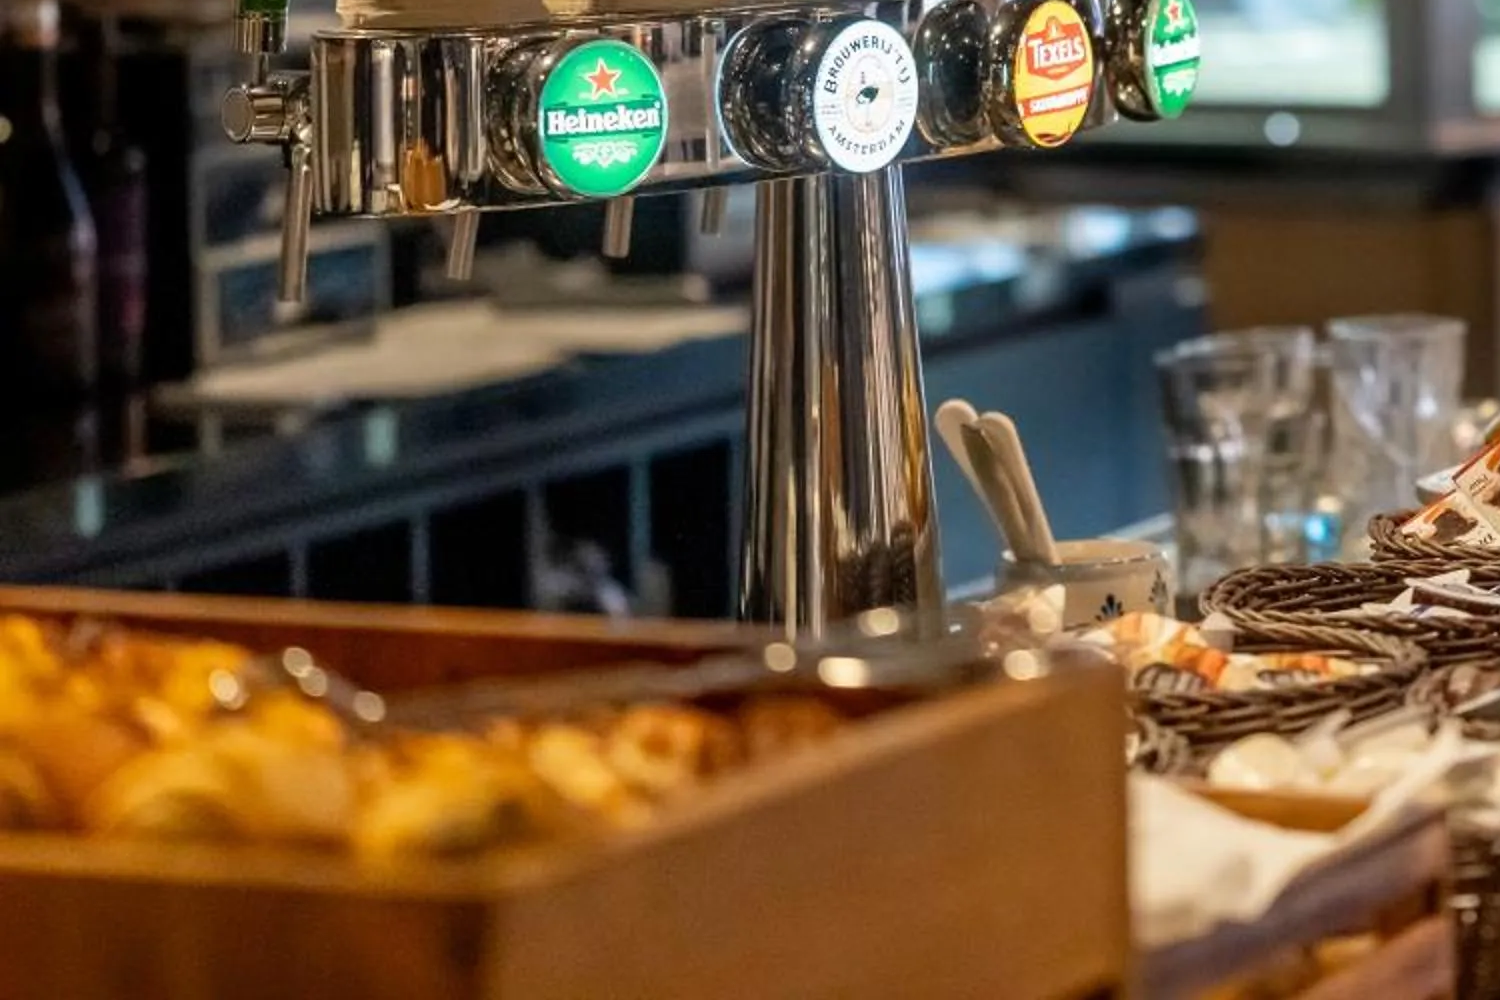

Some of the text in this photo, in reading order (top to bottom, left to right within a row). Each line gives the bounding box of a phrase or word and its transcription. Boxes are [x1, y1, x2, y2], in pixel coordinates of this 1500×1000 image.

[823, 35, 893, 94] BROUWERIJ
[547, 103, 660, 135] Heineken
[828, 119, 905, 155] AMSTERDAM
